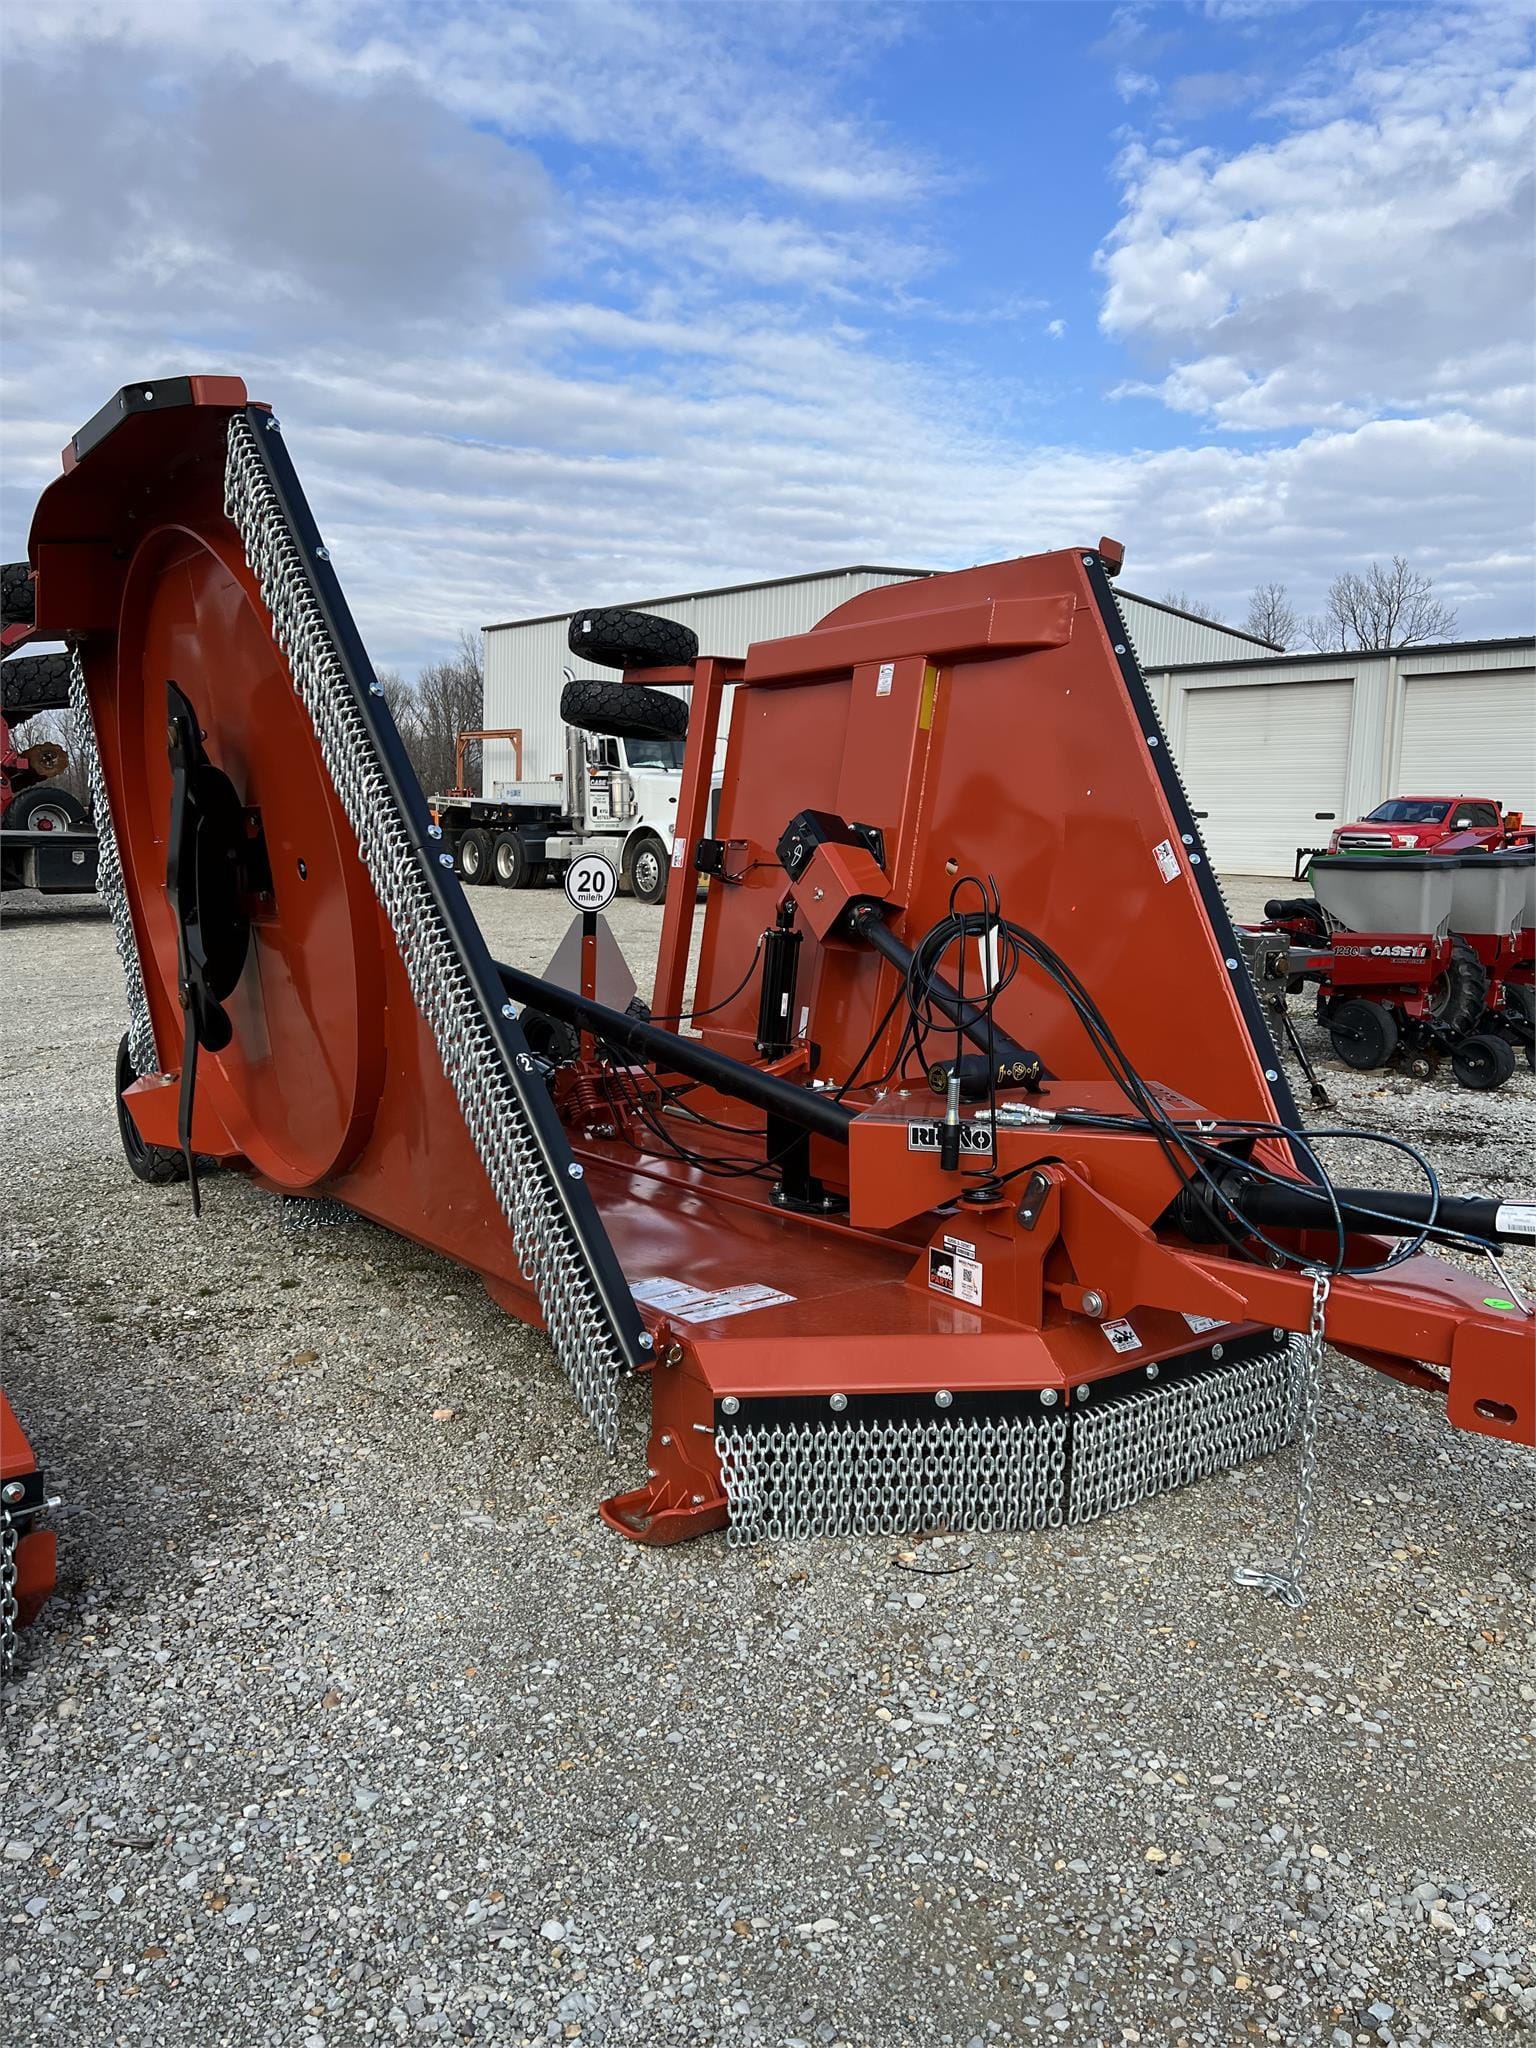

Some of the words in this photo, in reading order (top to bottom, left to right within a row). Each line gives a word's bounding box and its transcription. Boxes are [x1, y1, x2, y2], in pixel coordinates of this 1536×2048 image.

[577, 870, 605, 893] 20
[578, 893, 604, 902] mile/h
[521, 1057, 533, 1071] 2
[911, 1126, 993, 1150] RHNO
[931, 1273, 953, 1289] PARTS
